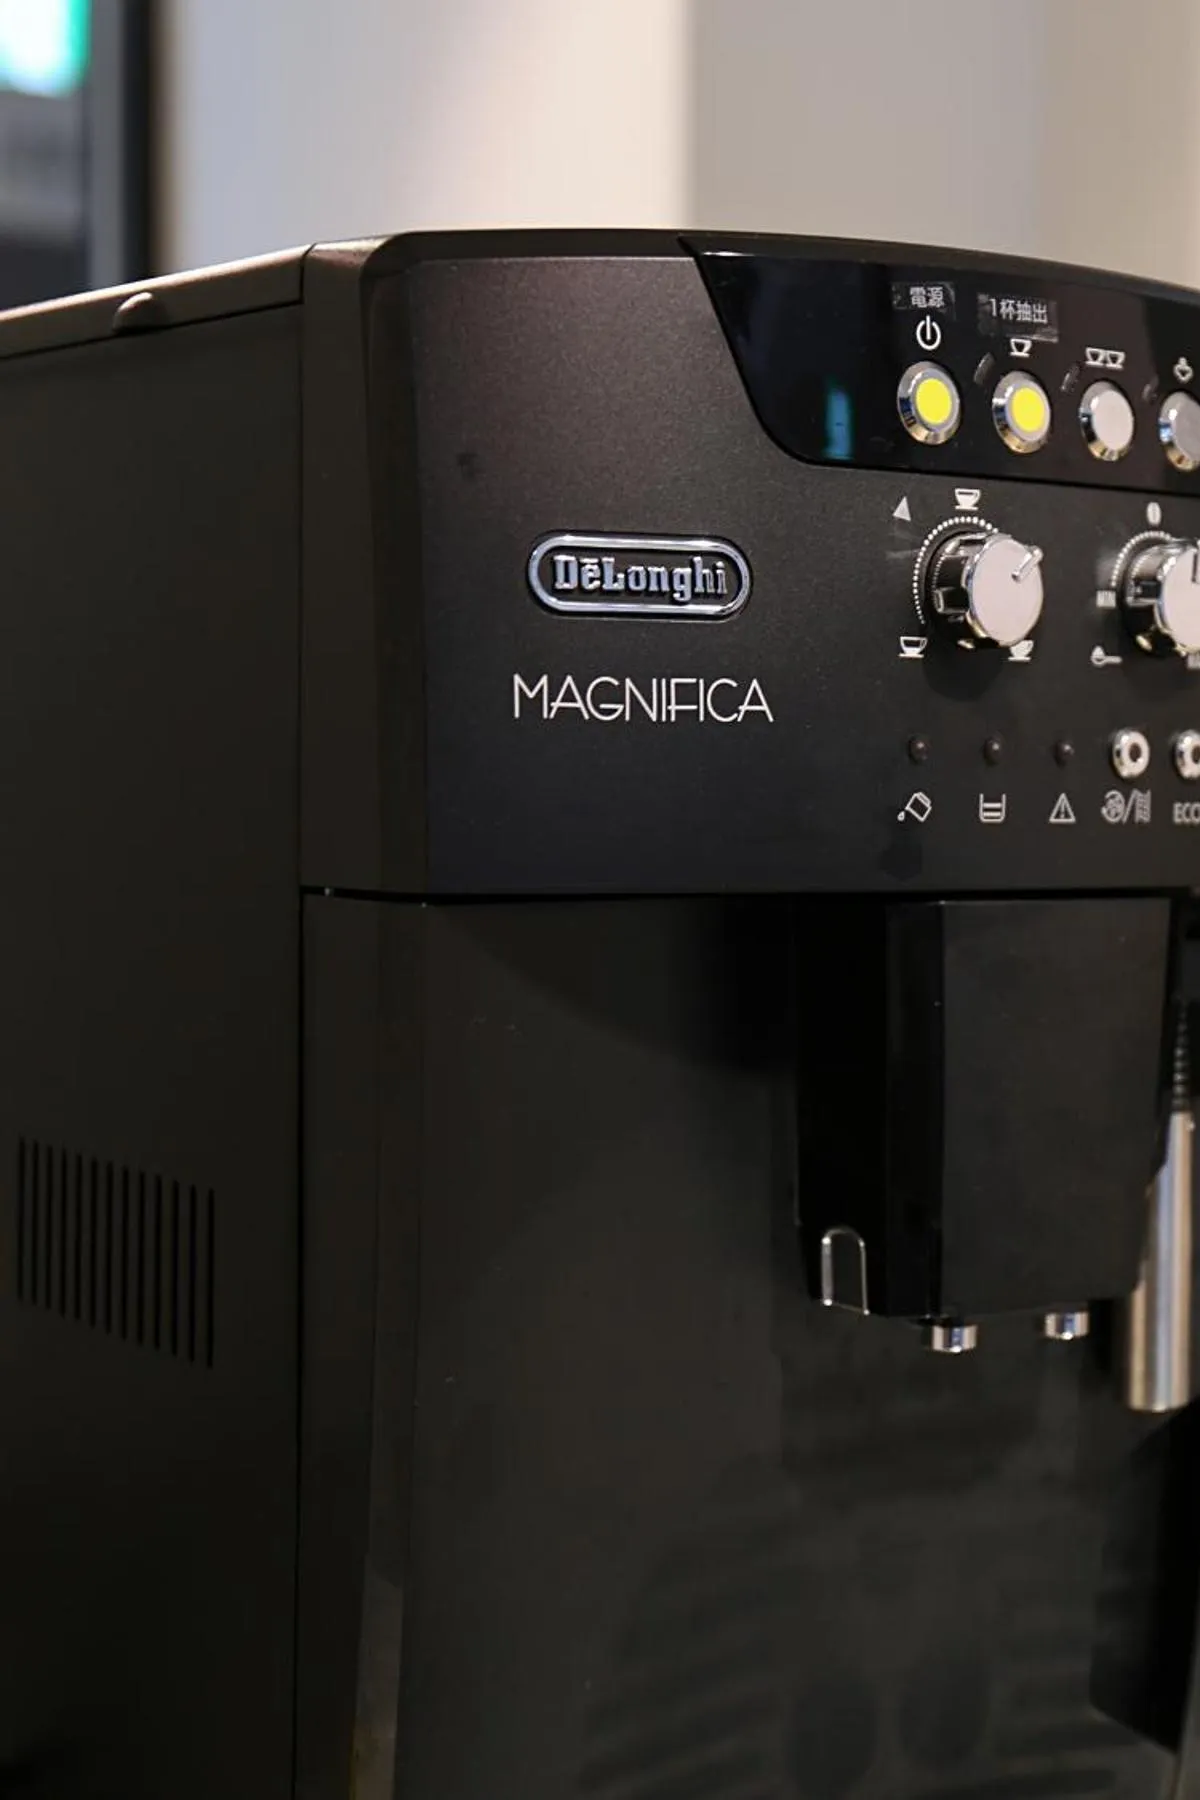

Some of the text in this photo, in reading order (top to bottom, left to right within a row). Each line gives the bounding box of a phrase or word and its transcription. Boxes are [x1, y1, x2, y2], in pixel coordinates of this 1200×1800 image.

[909, 286, 944, 308] 電源
[989, 298, 1048, 323] 1杯抽出
[513, 673, 774, 723] MAGNIFICA
